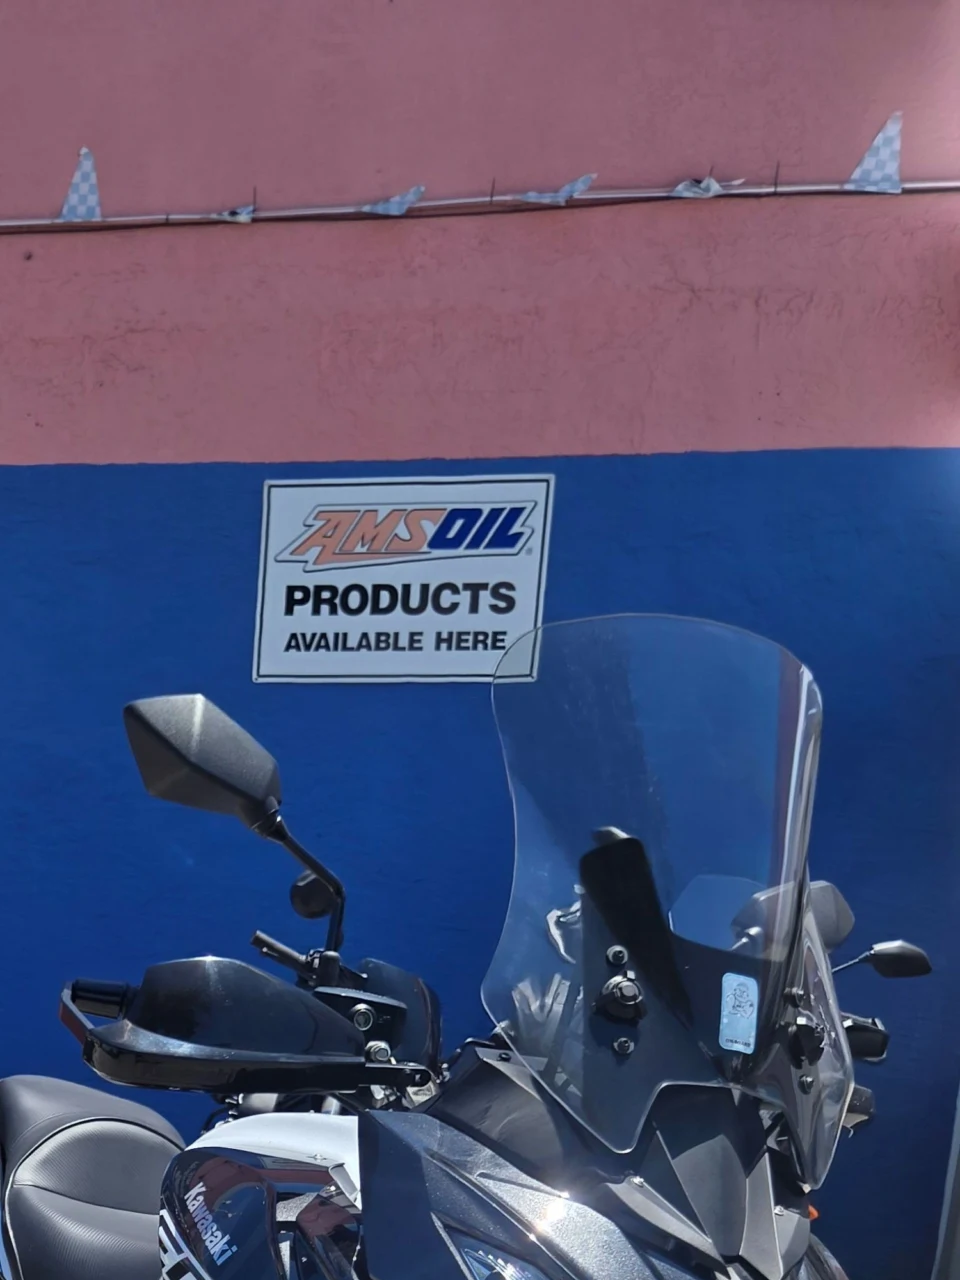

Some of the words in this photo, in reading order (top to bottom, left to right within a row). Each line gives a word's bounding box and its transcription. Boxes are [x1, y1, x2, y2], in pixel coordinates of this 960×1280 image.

[289, 507, 528, 566] AMSOIL
[284, 582, 517, 616] PRODUCTS
[283, 632, 424, 653] AVAILABLE
[434, 631, 508, 652] HERE
[183, 1181, 239, 1266] Kawasaki
